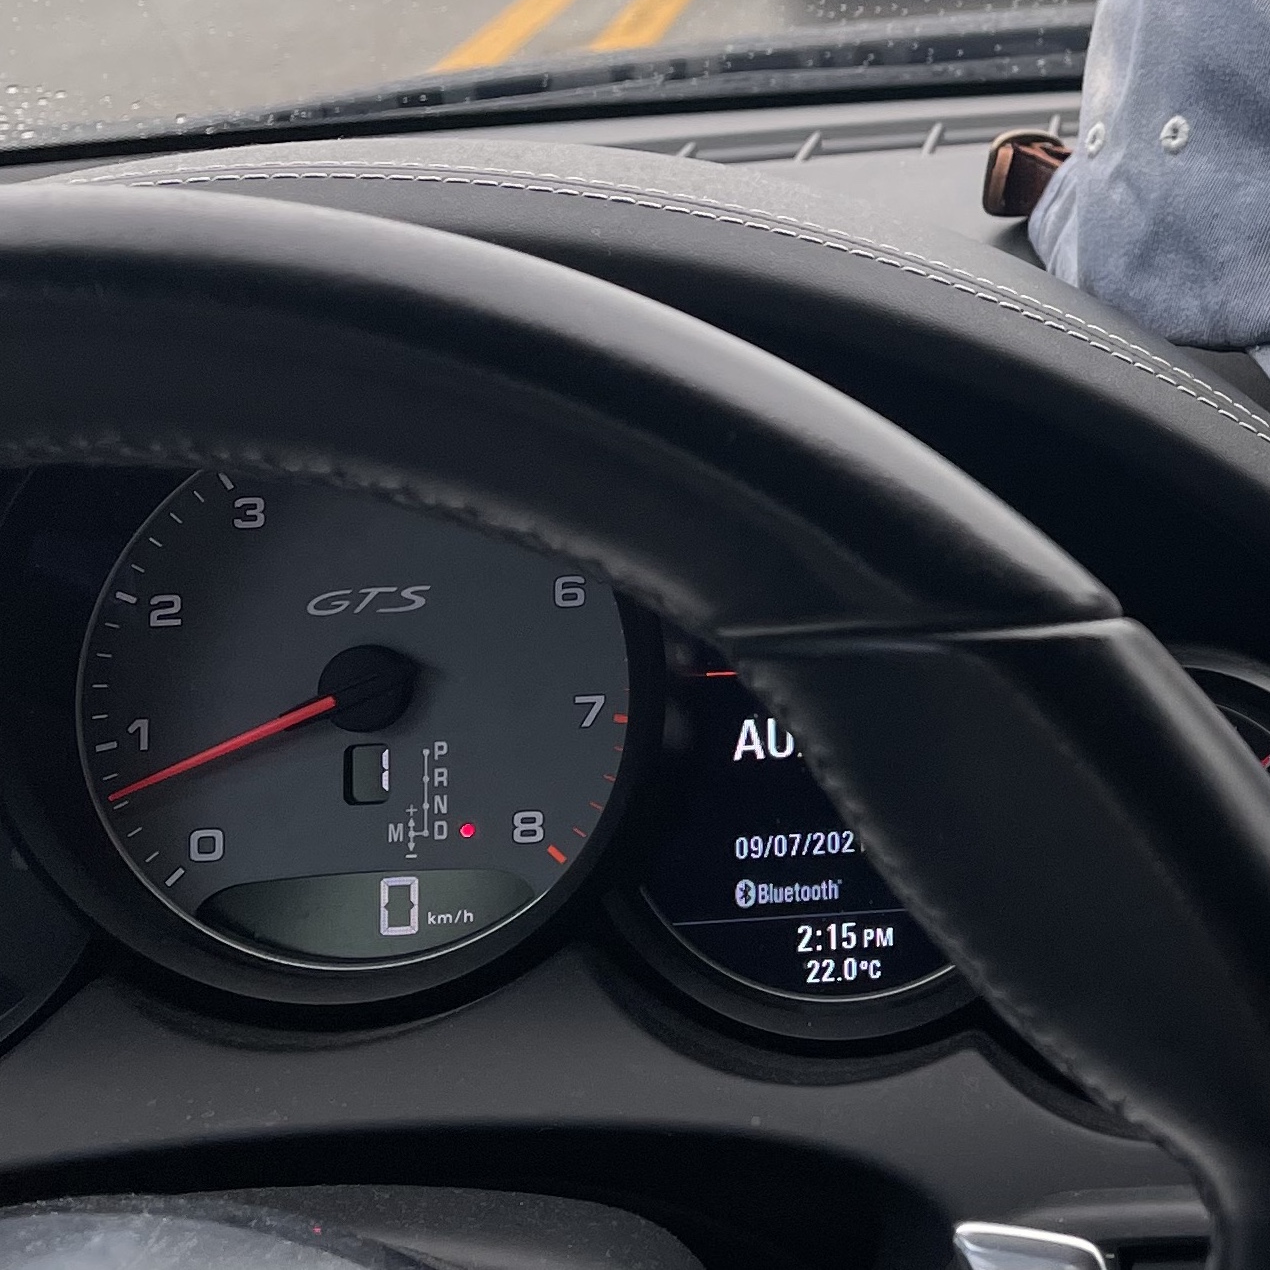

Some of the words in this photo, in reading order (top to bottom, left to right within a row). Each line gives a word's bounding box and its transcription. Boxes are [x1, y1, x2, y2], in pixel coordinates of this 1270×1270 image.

[233, 496, 266, 529] 3
[306, 585, 431, 616] GTS
[554, 575, 586, 608] 6
[149, 594, 183, 627] 2
[573, 694, 606, 728] 7
[127, 718, 150, 751] 1
[733, 718, 803, 761] AU
[433, 741, 448, 761] P
[433, 767, 448, 787] R
[433, 794, 448, 814] N
[388, 823, 404, 843] M
[433, 820, 448, 840] D
[512, 810, 545, 844] 8
[189, 828, 224, 862] 0
[735, 830, 865, 860] 09/07/202
[380, 876, 419, 936] 0
[427, 909, 474, 925] km/h
[757, 880, 840, 904] Bluetooth
[796, 922, 857, 952] 2:15
[863, 927, 894, 947] PM
